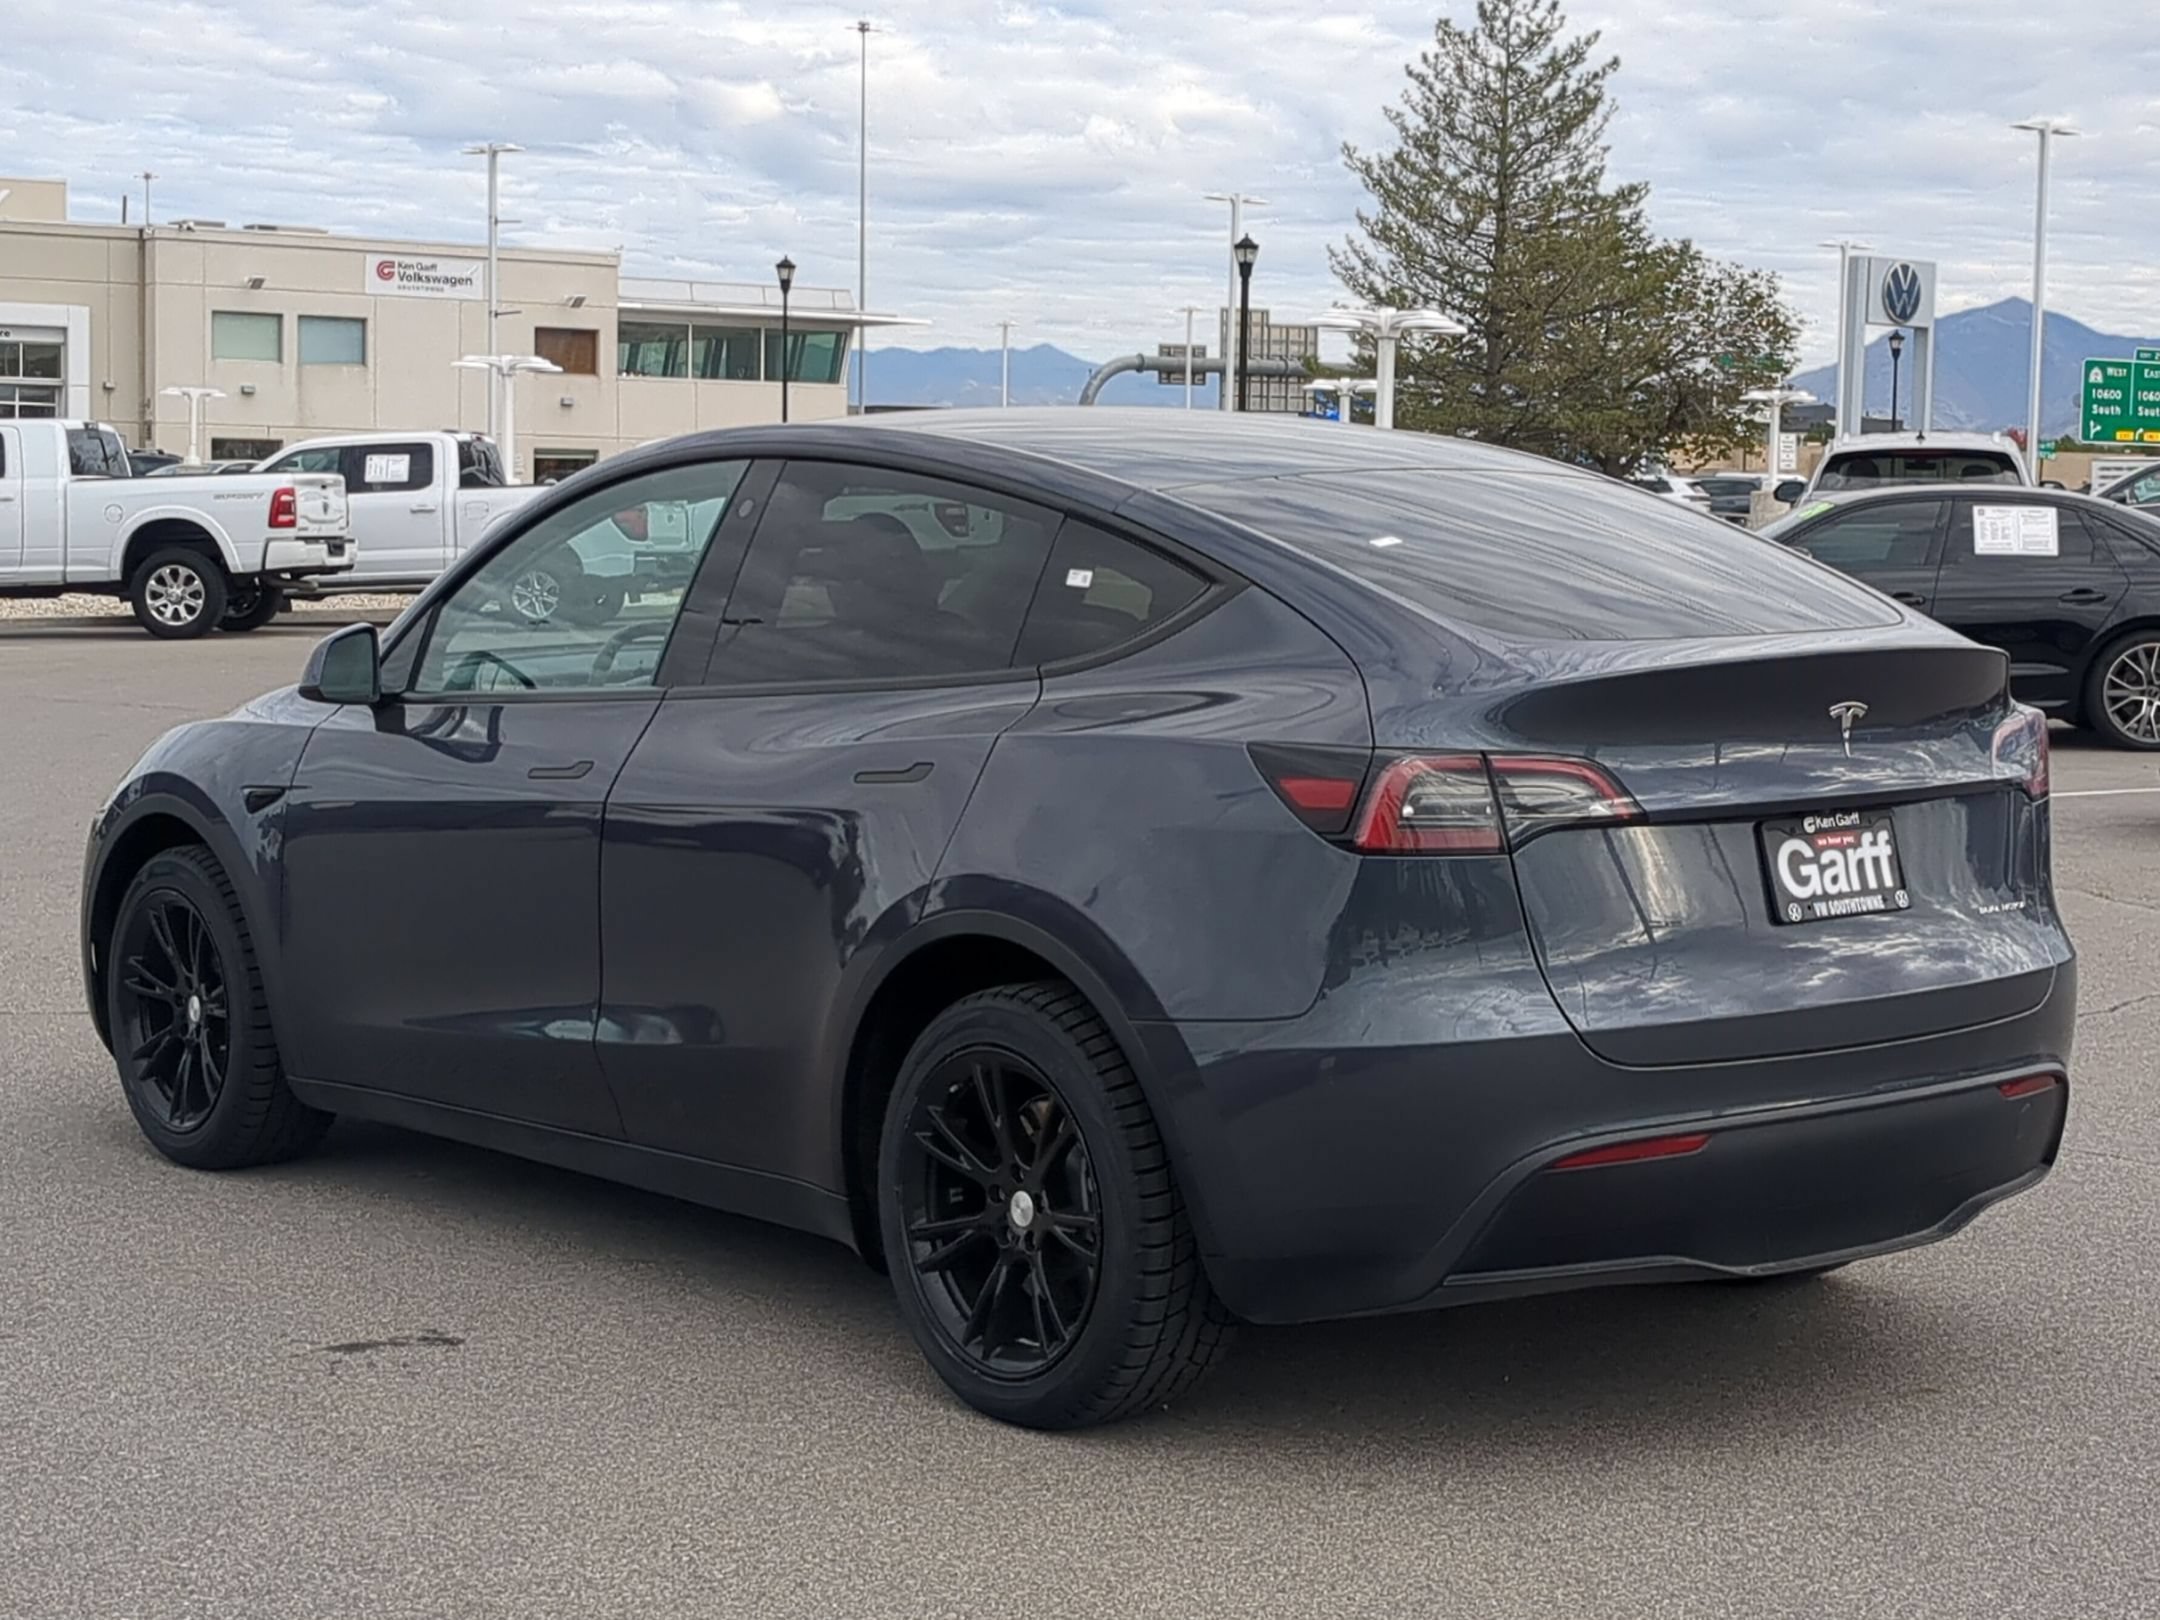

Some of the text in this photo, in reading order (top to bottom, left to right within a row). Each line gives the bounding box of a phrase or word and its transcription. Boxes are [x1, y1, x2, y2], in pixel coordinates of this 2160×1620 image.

[397, 260, 415, 271] Ken
[397, 271, 473, 287] Volkswagen
[2091, 387, 2122, 400] 10600
[2091, 403, 2122, 416] South
[1815, 812, 1860, 829] Ken Garff
[1777, 829, 1895, 899] Garff
